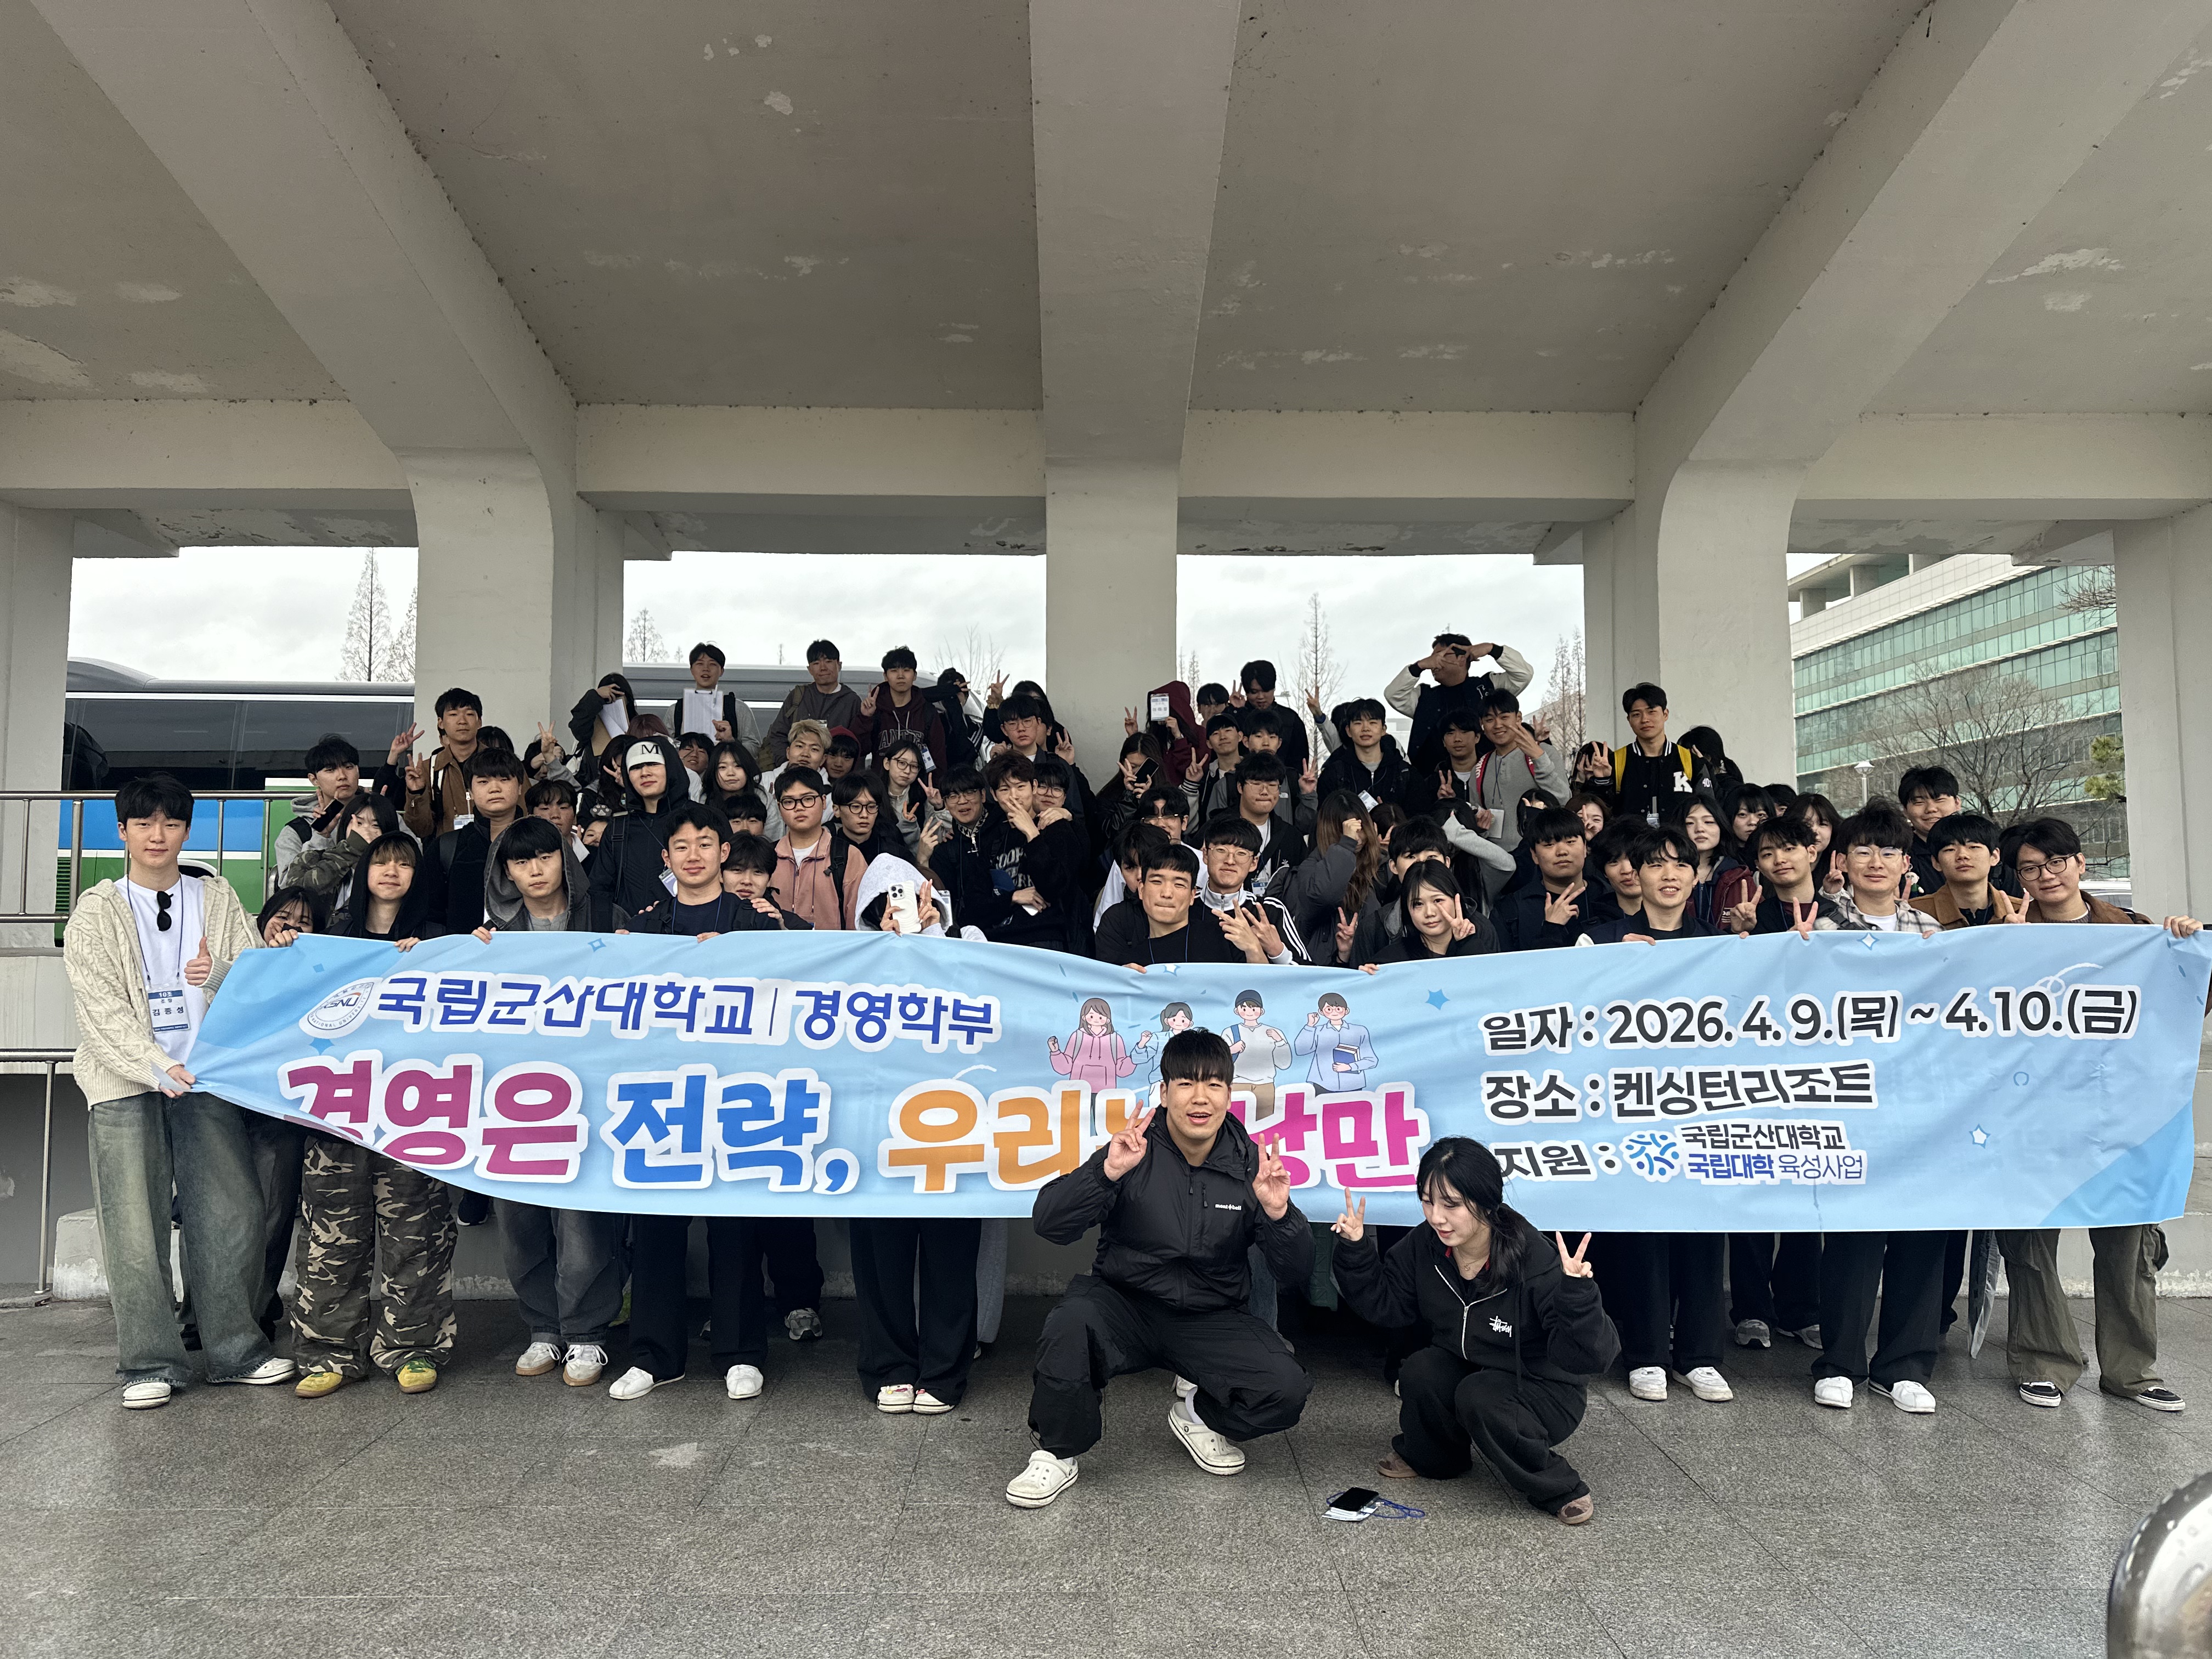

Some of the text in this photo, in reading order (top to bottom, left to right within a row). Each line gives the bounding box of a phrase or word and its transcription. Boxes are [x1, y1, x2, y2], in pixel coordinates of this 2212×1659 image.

[641, 744, 660, 755] M
[1673, 771, 1693, 793] K
[377, 977, 993, 1046] 국립군산대학교 경영학부
[1613, 1063, 1872, 1118] 켄싱턴리조트
[611, 1074, 849, 1192] 전략,
[1680, 1124, 1846, 1150] 국립군산대학교
[1688, 1153, 1863, 1180] 국립대학 육성사업
